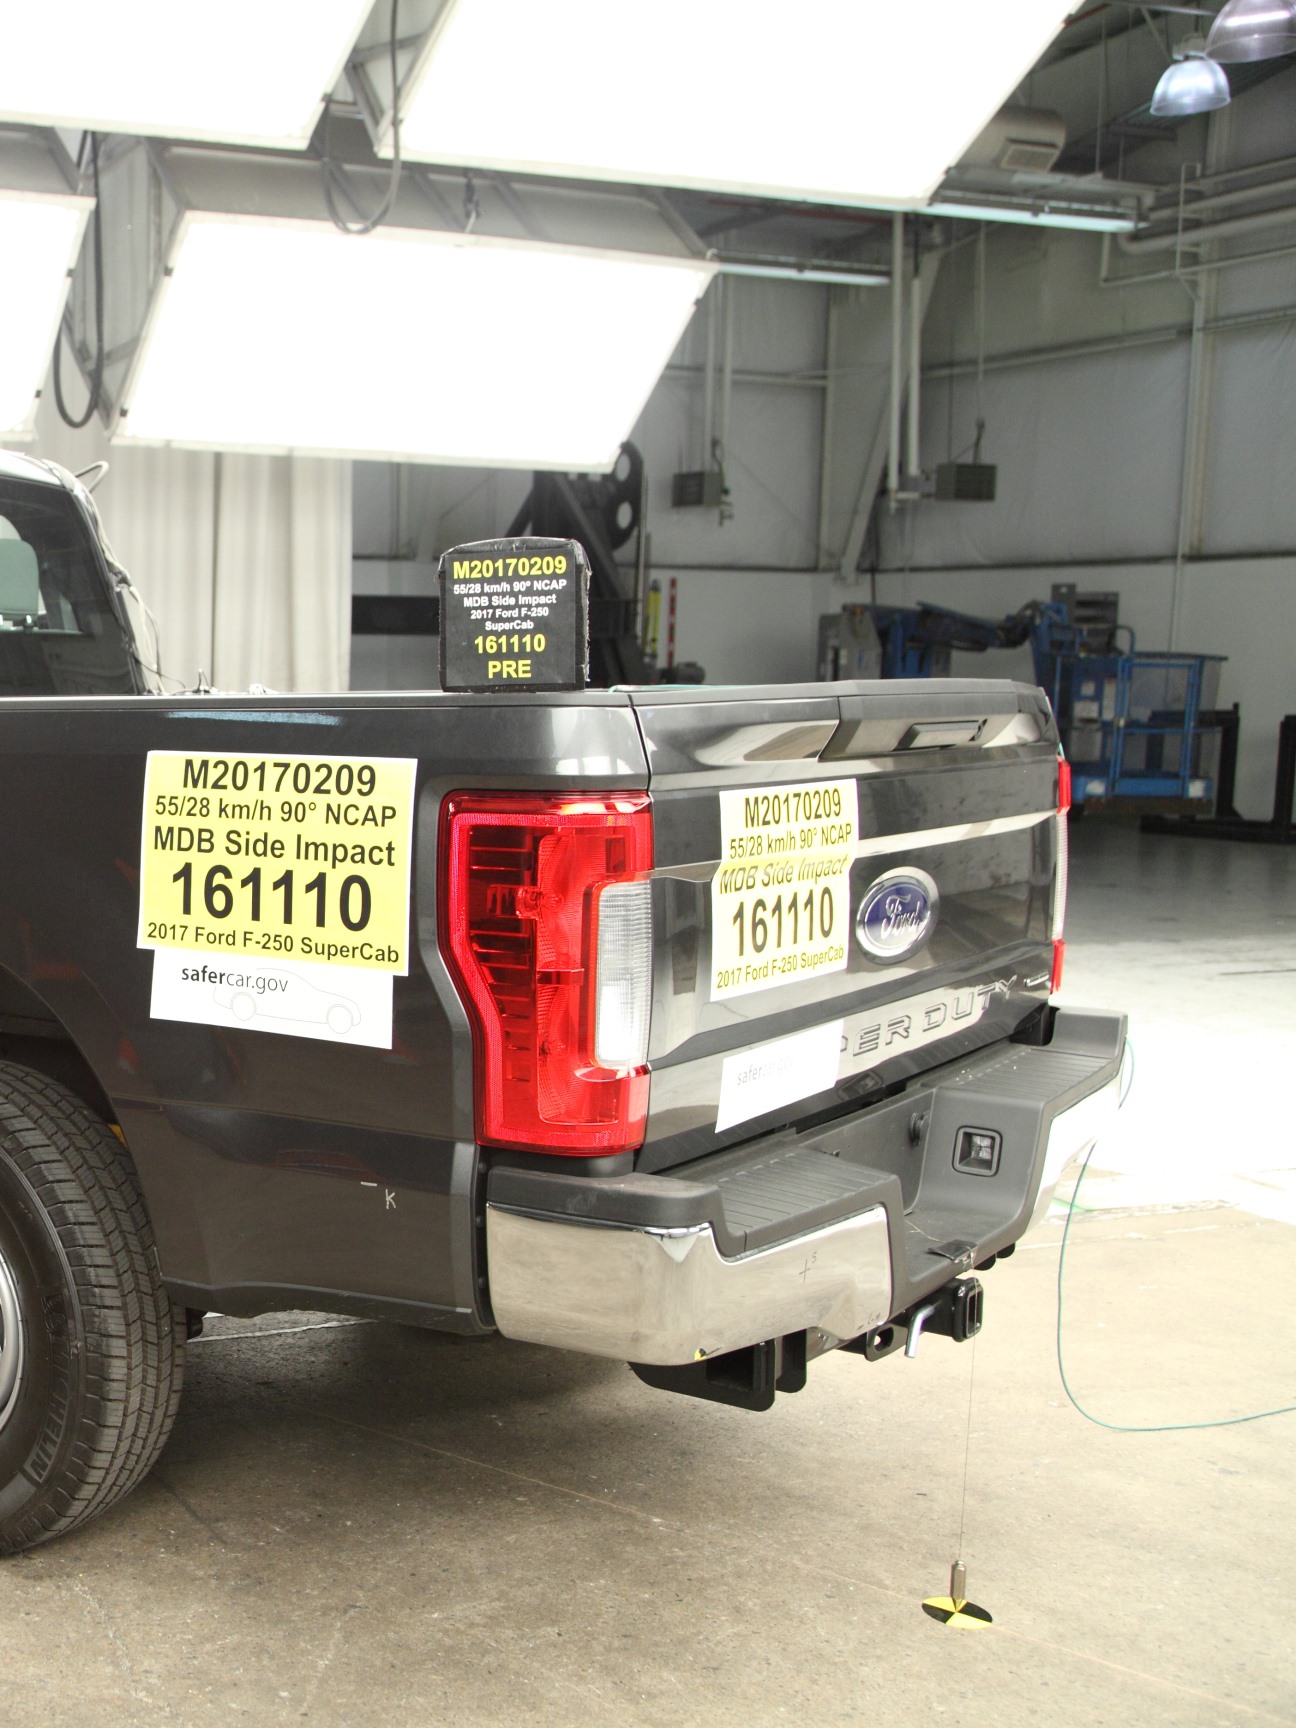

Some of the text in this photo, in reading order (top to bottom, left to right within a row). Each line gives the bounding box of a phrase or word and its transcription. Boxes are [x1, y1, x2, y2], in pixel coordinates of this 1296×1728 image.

[453, 556, 567, 579] M20170209
[454, 584, 481, 595] 55/28
[484, 582, 510, 593] km/h
[533, 579, 567, 591] NCAP
[464, 594, 556, 607] MDB Side Impact
[471, 607, 549, 619] 2017 Ford F-250
[485, 620, 534, 632] SuperCab
[474, 634, 545, 654] 161110
[488, 660, 531, 678] PRE
[183, 759, 376, 796] M20170209
[155, 796, 210, 817] 55/28
[218, 798, 272, 821] km/h
[325, 803, 396, 827] NCAP
[745, 788, 841, 828] M20170209
[154, 826, 395, 869] MDB Side Impact
[730, 837, 763, 859] 55/28
[767, 832, 796, 853] km/h
[821, 823, 852, 845] NCAP
[719, 854, 848, 894] MDB Side Impact
[172, 862, 371, 932] 161110
[732, 886, 834, 957] 161110
[881, 894, 922, 939] Ford
[147, 922, 399, 963] 2017 Ford F-250 SuperCab
[181, 965, 288, 994] safercar.gov
[717, 944, 844, 989] 2017 Ford F-250 SuperCab
[840, 974, 1017, 1056] ER DUTY
